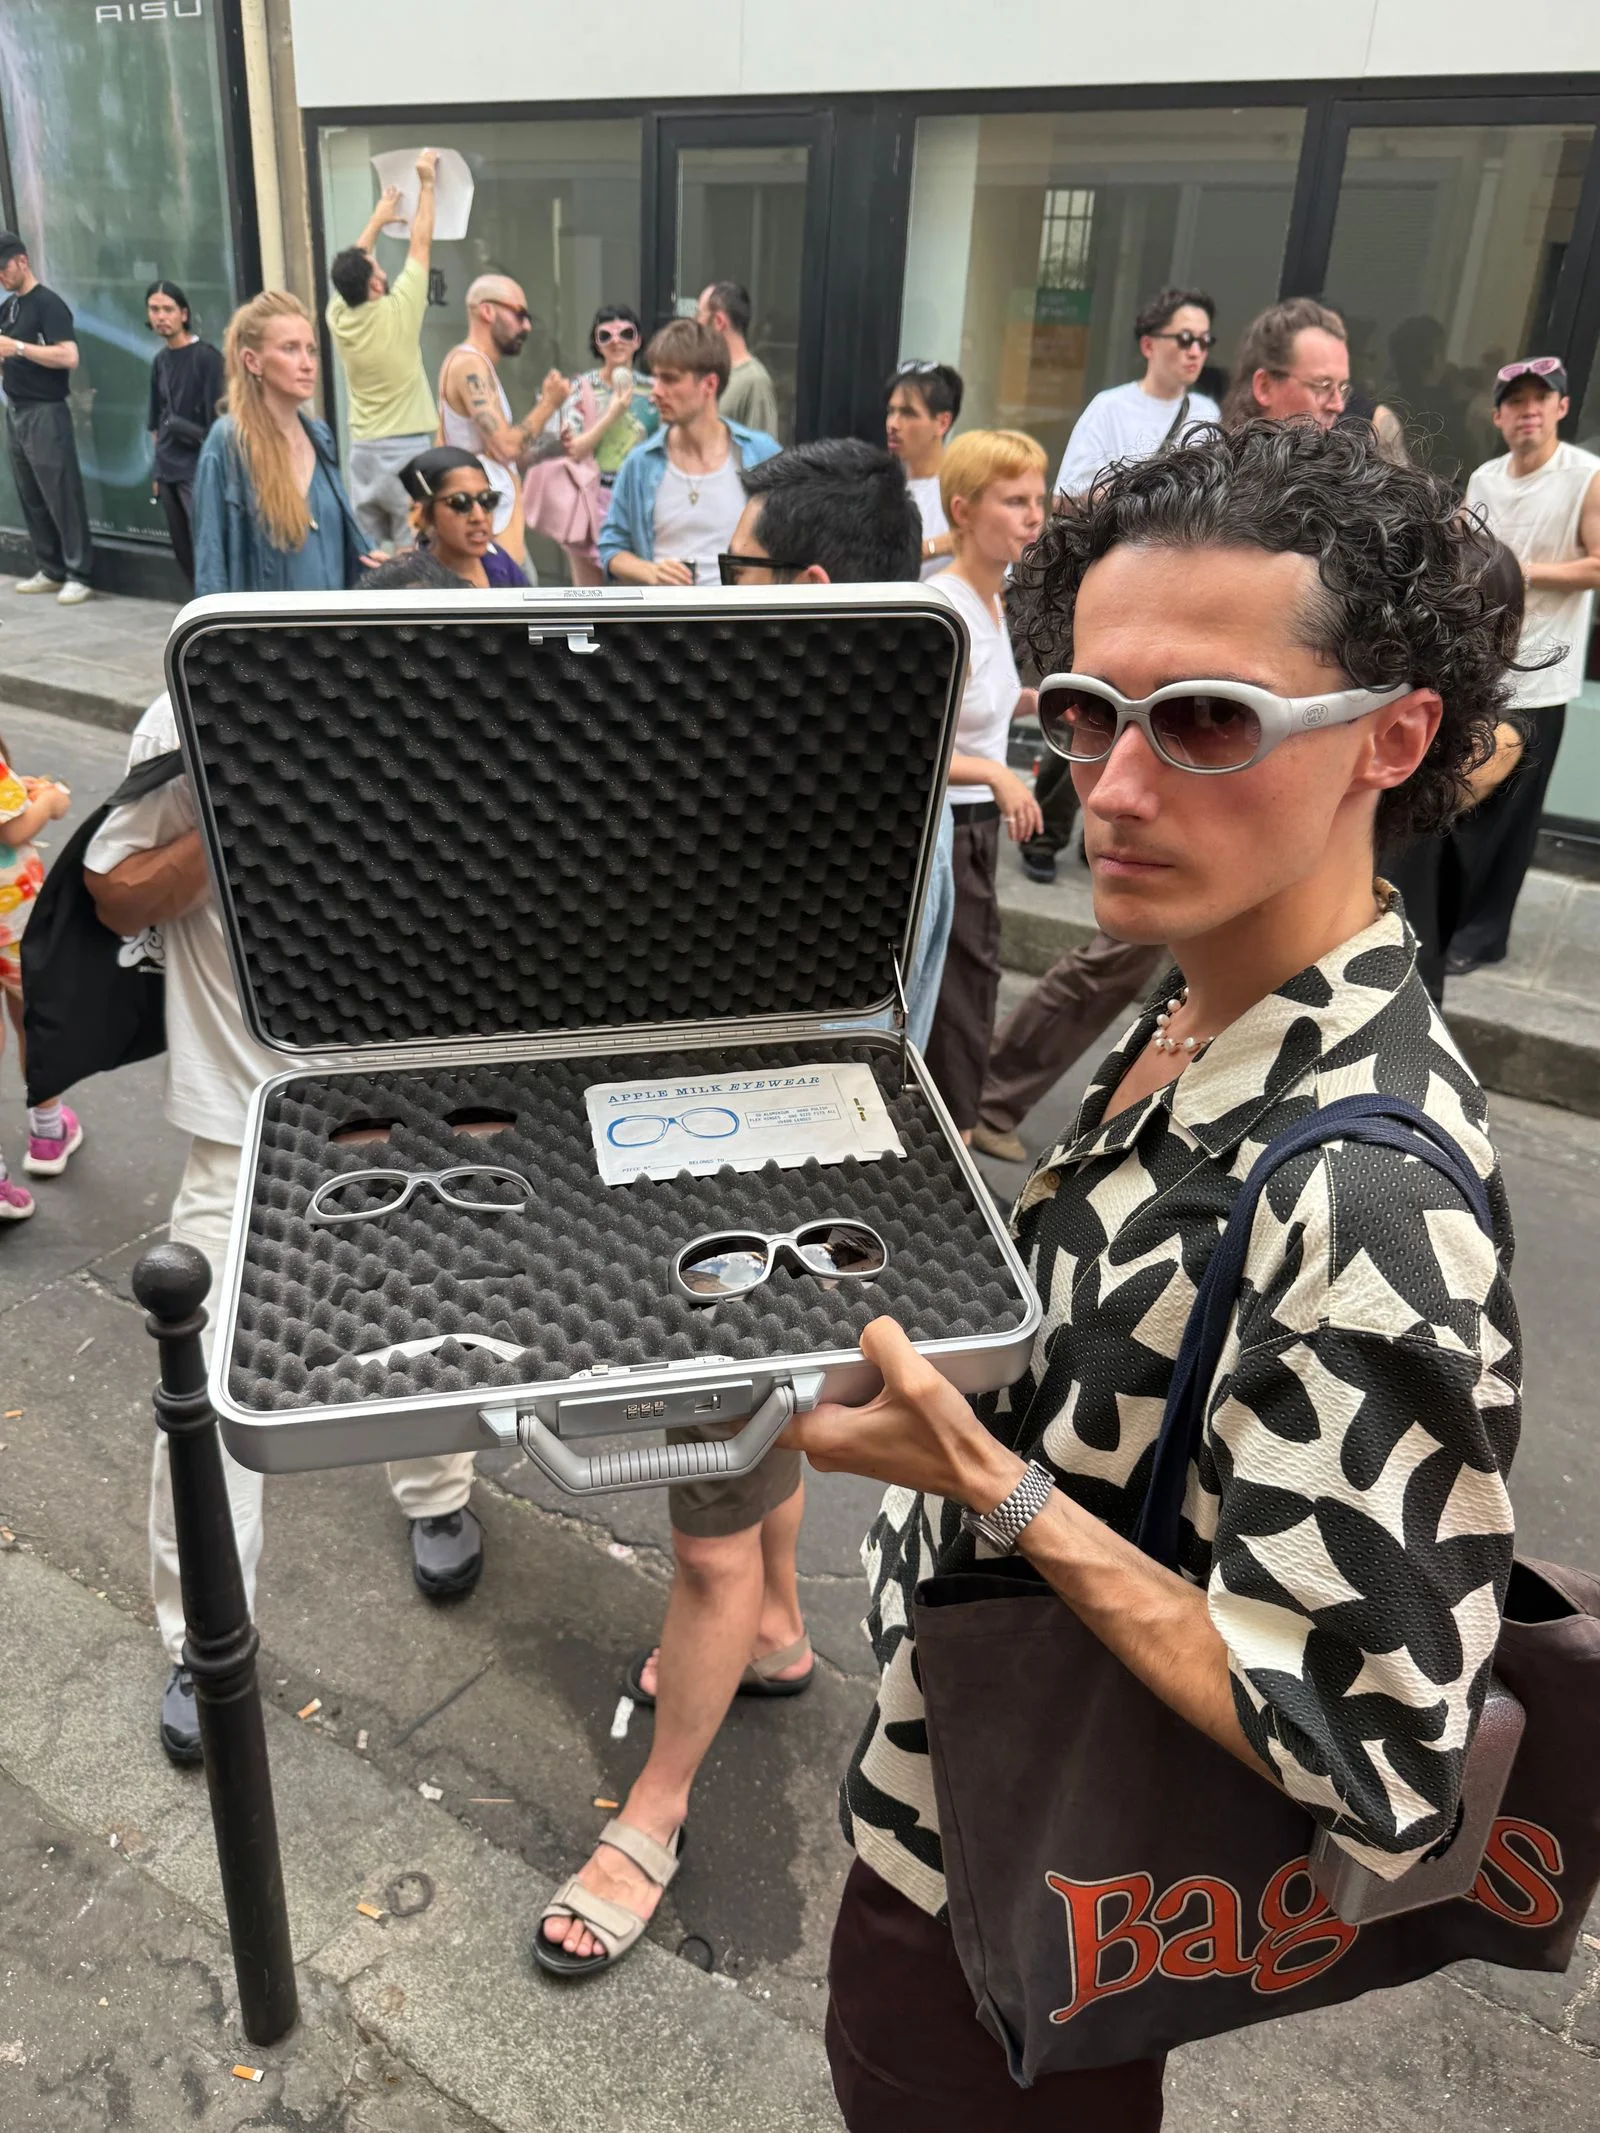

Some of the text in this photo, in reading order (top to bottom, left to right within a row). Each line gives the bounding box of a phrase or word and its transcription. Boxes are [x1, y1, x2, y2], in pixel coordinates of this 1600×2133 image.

[95, 0, 202, 23] AISU
[1305, 706, 1326, 717] APPLE
[607, 1076, 820, 1104] APPLE MILK EYEWEAR
